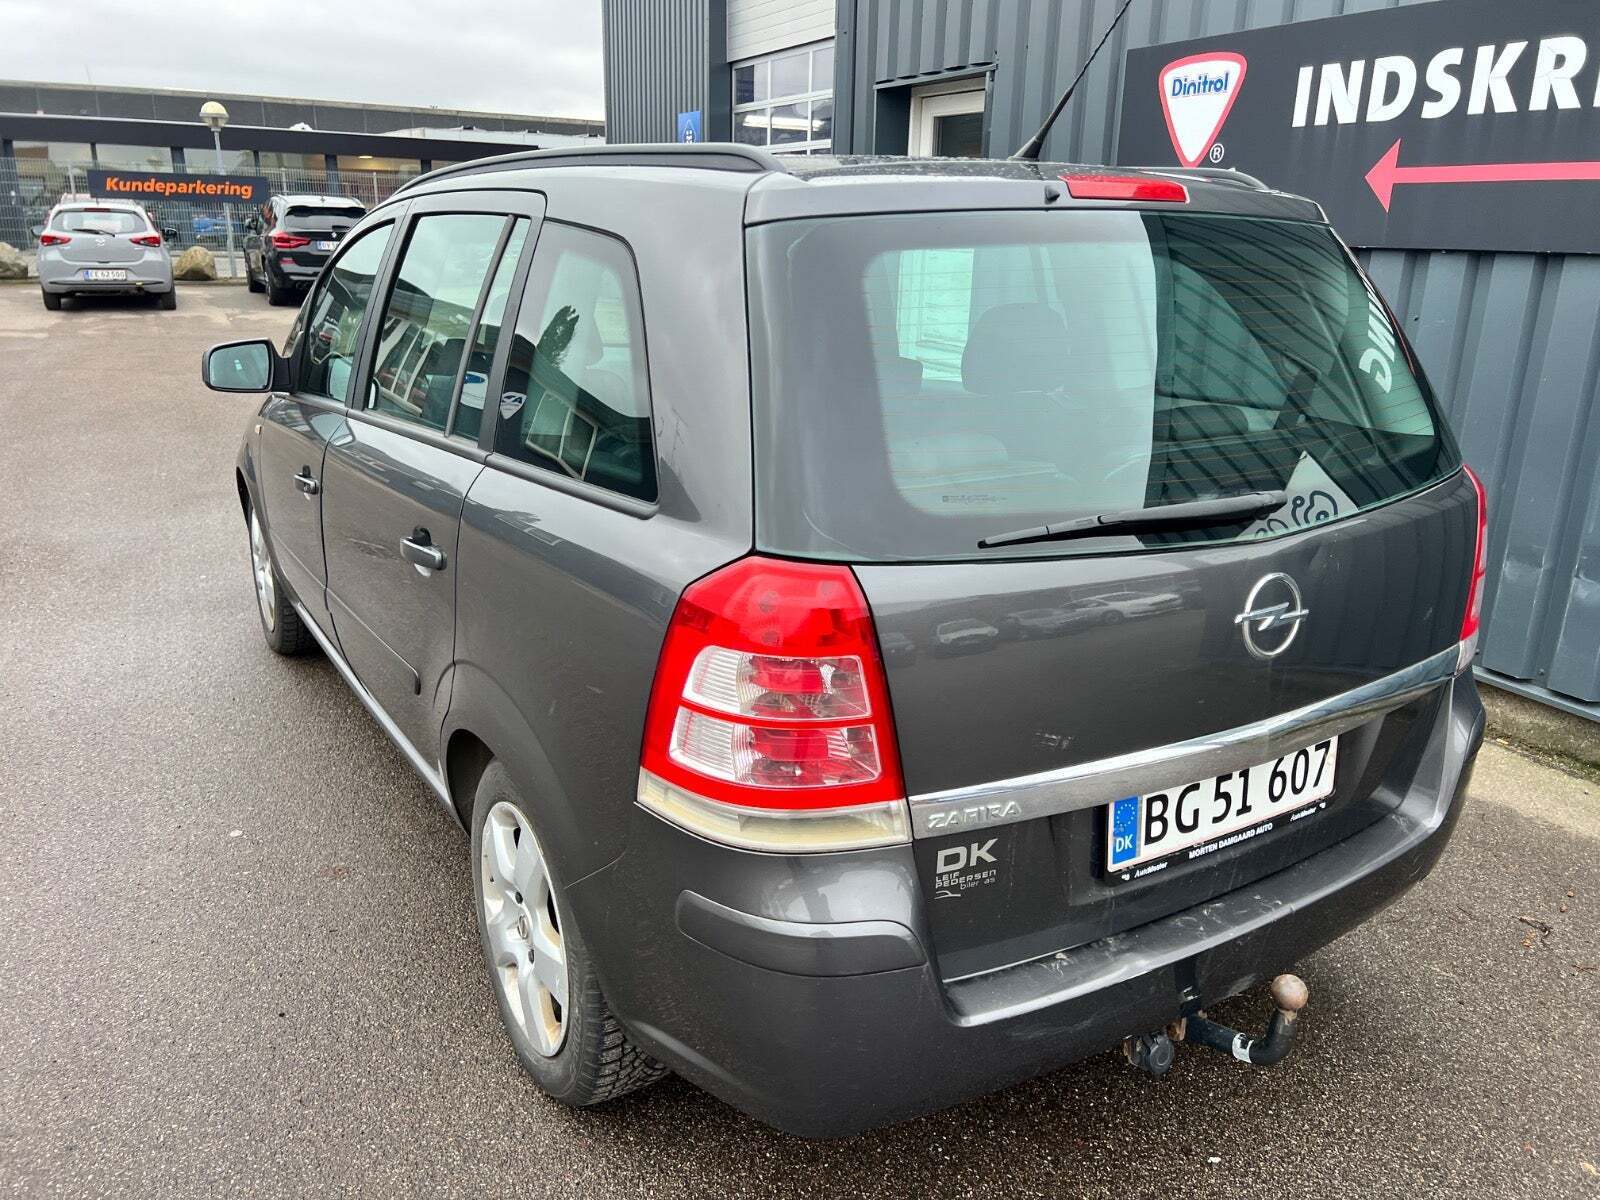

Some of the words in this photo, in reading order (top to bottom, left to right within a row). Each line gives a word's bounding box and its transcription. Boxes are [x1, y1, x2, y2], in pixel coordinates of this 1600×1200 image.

[1171, 72, 1229, 97] Dinitrol
[105, 176, 253, 200] Kundeparkering
[1144, 782, 1201, 846] BG
[1212, 768, 1252, 824] 51
[1268, 740, 1332, 803] 607
[928, 801, 1022, 828] ZAFIRA
[1115, 834, 1134, 853] DK
[1189, 843, 1218, 859] MORTEN
[1219, 830, 1255, 849] DAMGAARD
[1256, 823, 1273, 835] AUTO
[936, 838, 998, 874] DK
[935, 872, 960, 882] LEIF
[935, 869, 997, 889] PEDERSEN
[960, 881, 979, 890] biler
